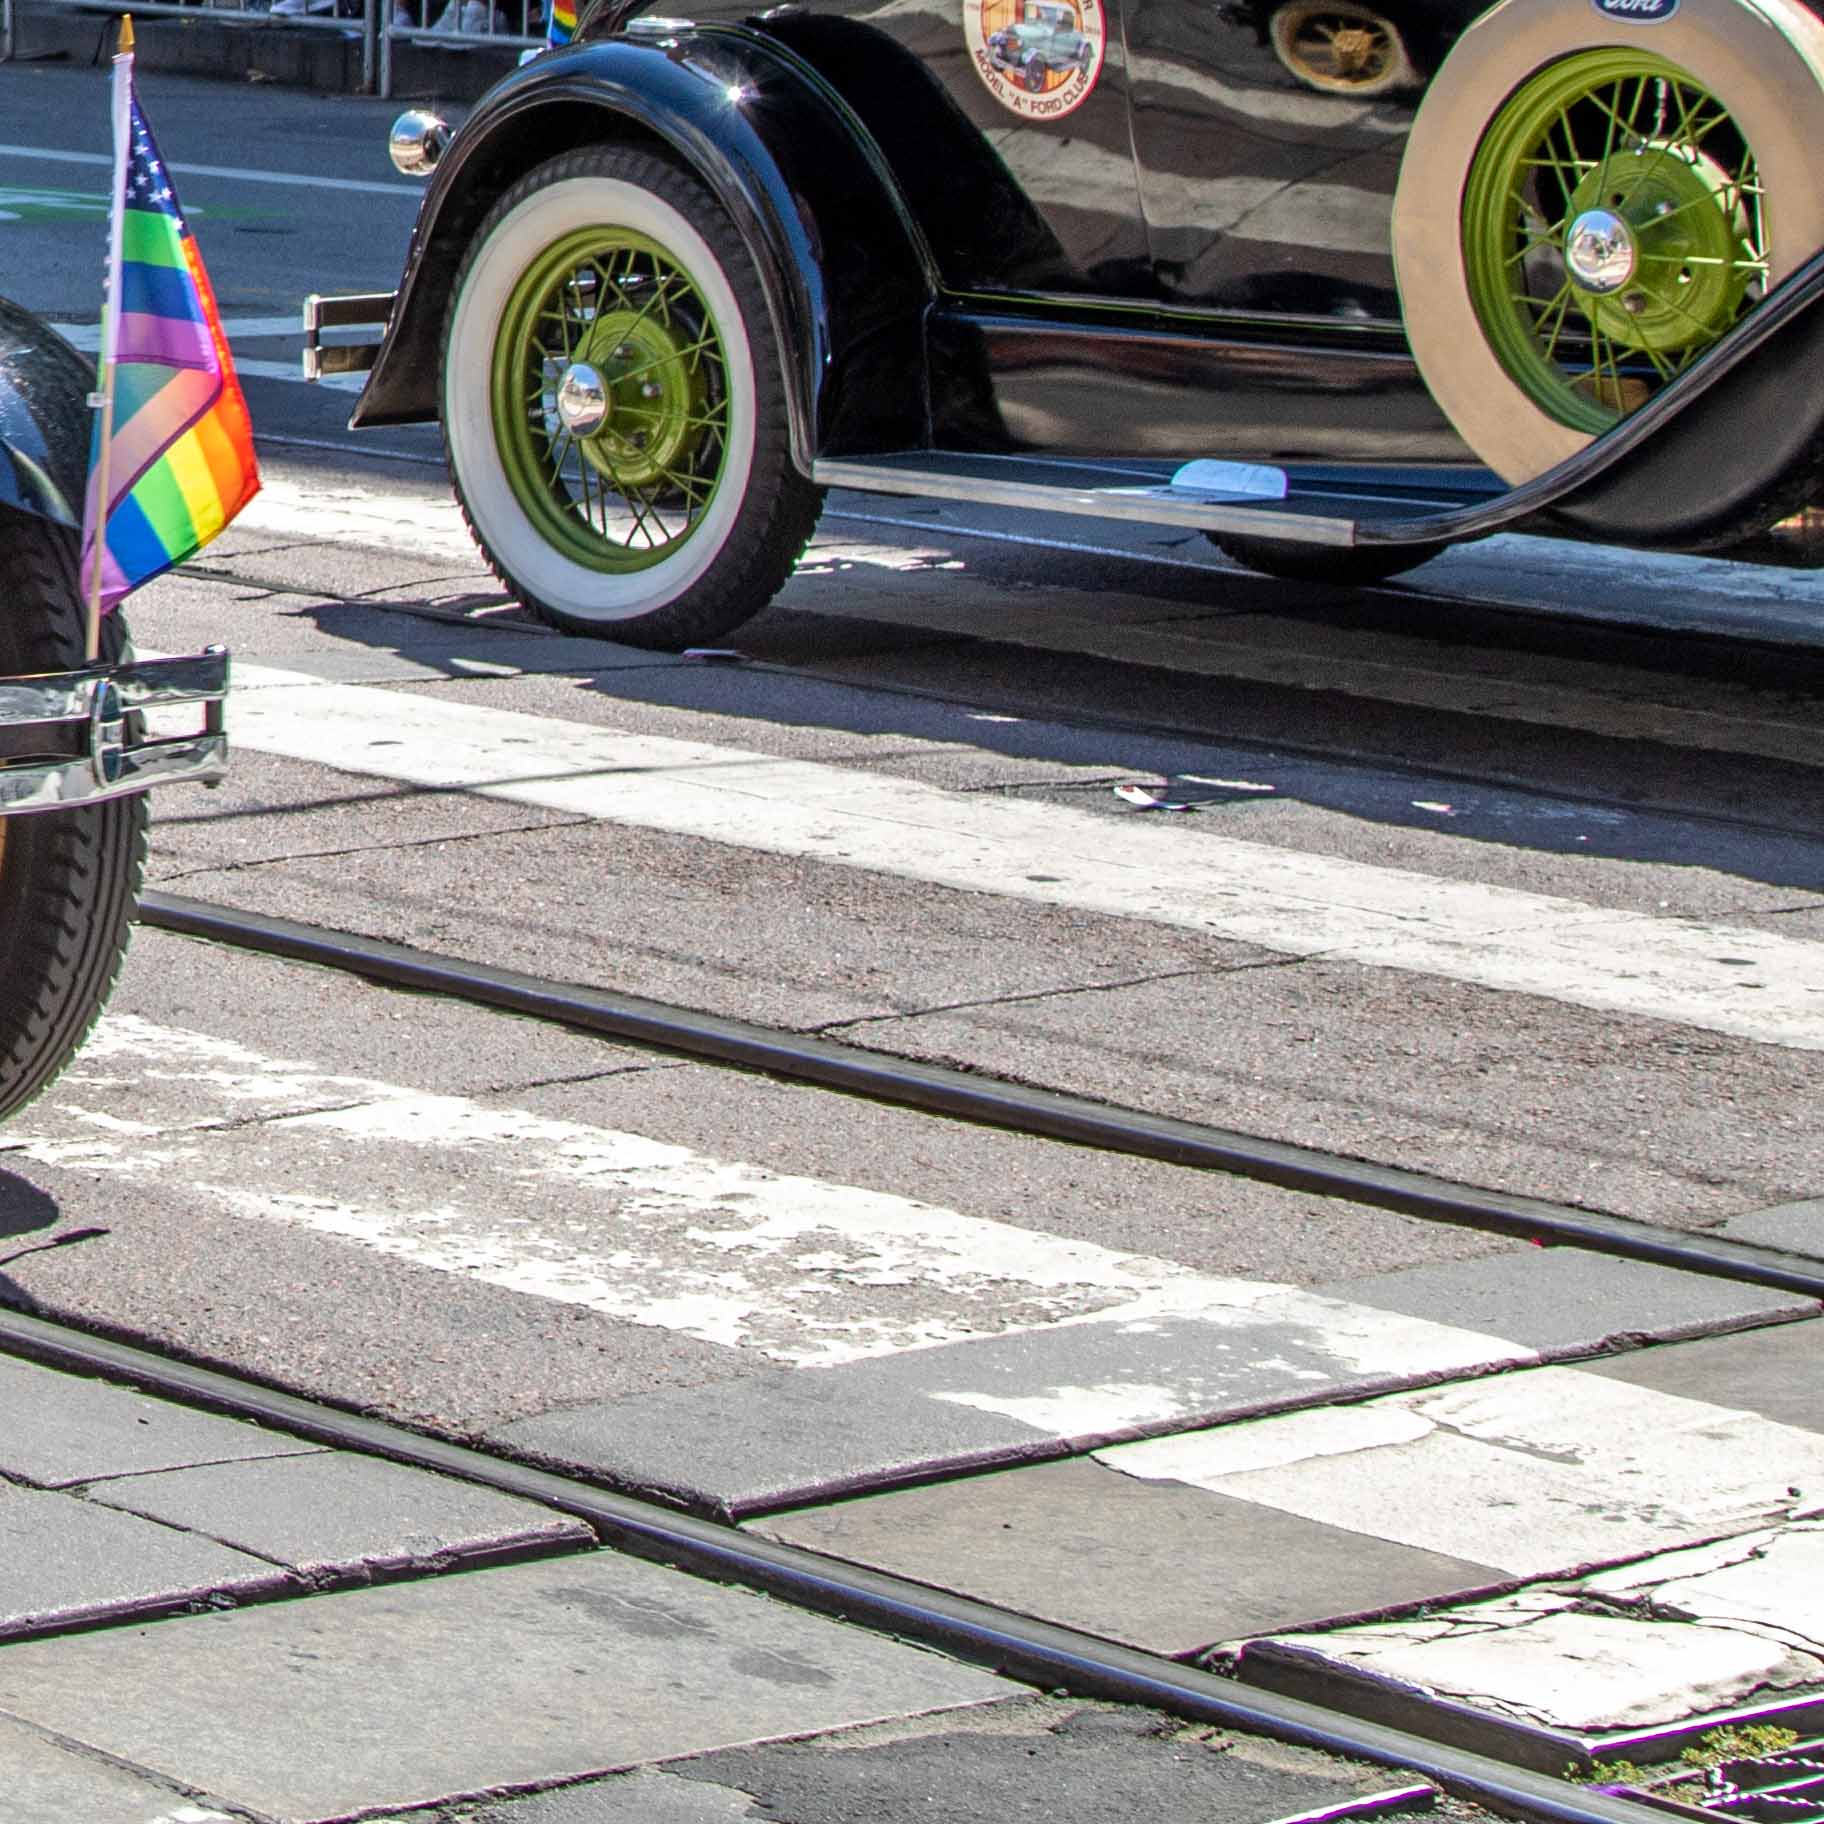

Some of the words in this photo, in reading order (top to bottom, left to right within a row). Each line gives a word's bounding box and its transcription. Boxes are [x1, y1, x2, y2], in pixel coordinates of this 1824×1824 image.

[975, 48, 1005, 97] MODEL
[1008, 92, 1028, 110] "A"
[1030, 97, 1063, 114] FORD
[1063, 71, 1089, 106] CLUB
